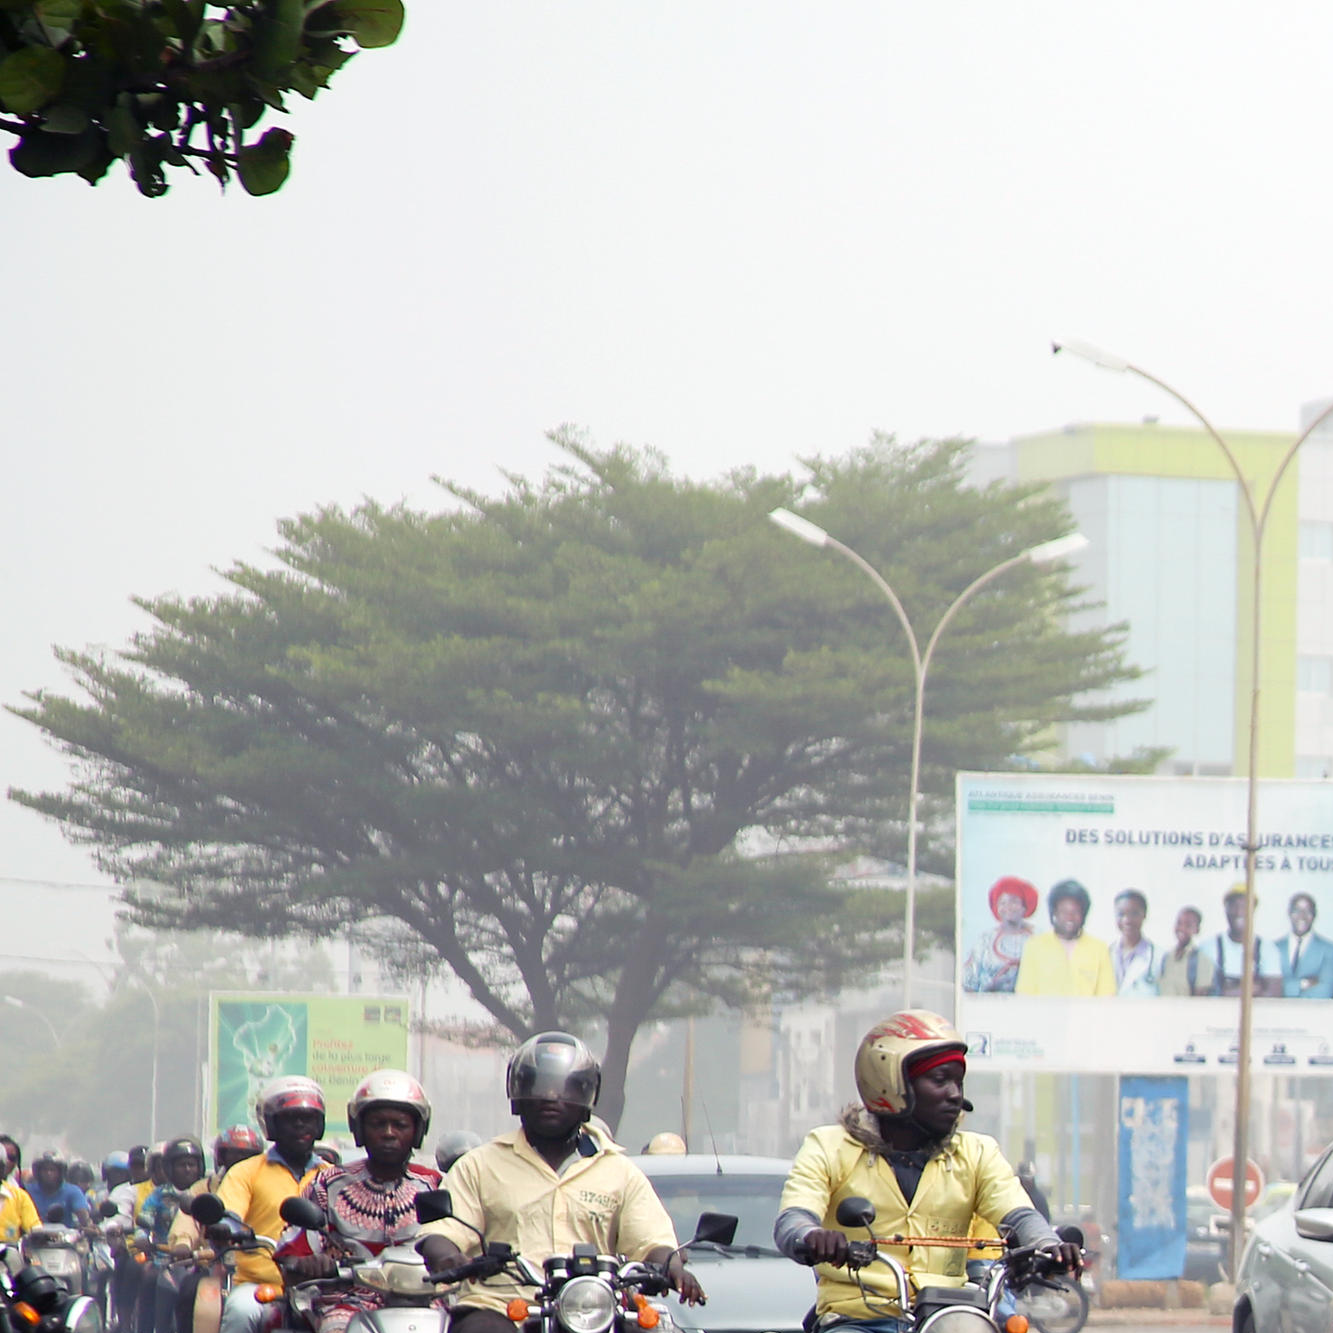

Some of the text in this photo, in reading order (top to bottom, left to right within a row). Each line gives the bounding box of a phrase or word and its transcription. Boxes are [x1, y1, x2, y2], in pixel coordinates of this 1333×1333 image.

[1065, 829, 1099, 845] DES
[1104, 830, 1203, 847] SOLUTIONS
[1280, 850, 1292, 871] À
